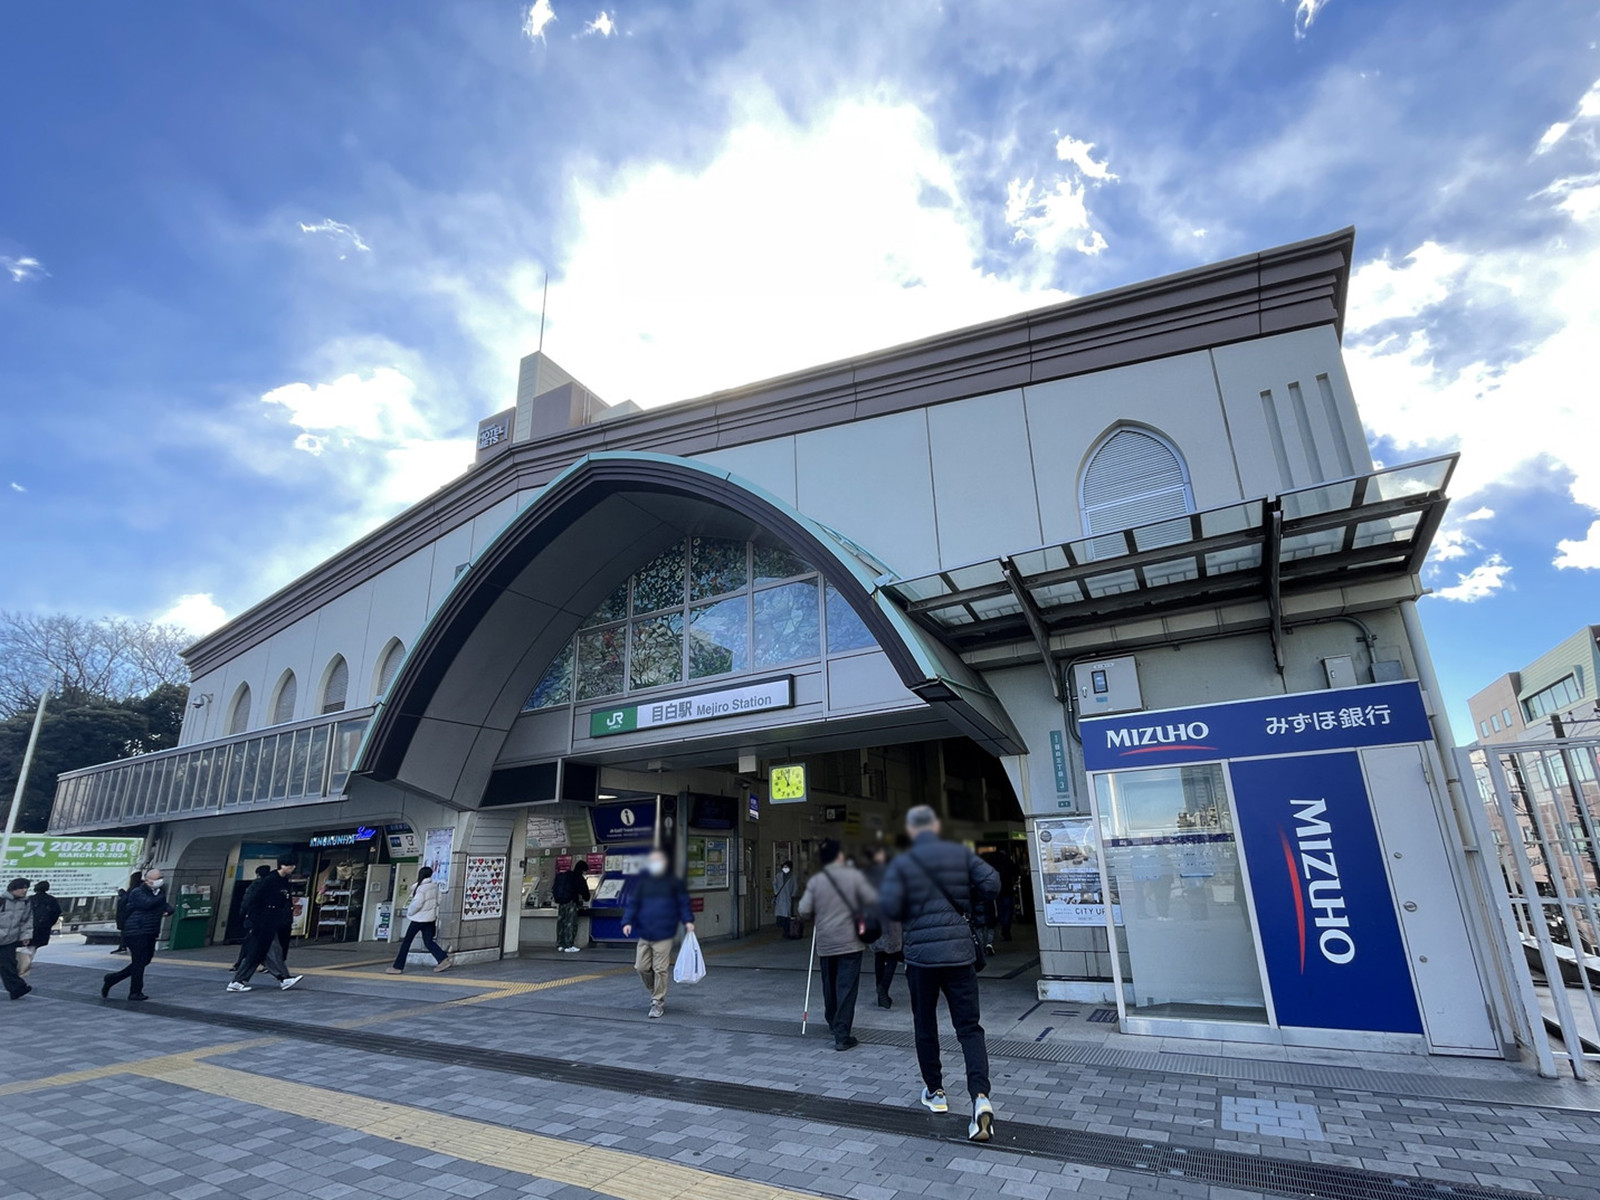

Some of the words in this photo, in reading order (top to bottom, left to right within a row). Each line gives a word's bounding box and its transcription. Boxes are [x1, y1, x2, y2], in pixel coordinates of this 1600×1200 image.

[652, 701, 692, 722] 目白駅
[696, 703, 729, 717] Mejiro
[732, 695, 772, 710] Station
[606, 712, 624, 726] JR
[1265, 704, 1391, 735] みずほ銀行
[1106, 722, 1210, 749] MIZUHO
[49, 841, 126, 853] 2024.3.10
[1290, 798, 1355, 964] MIZUHO
